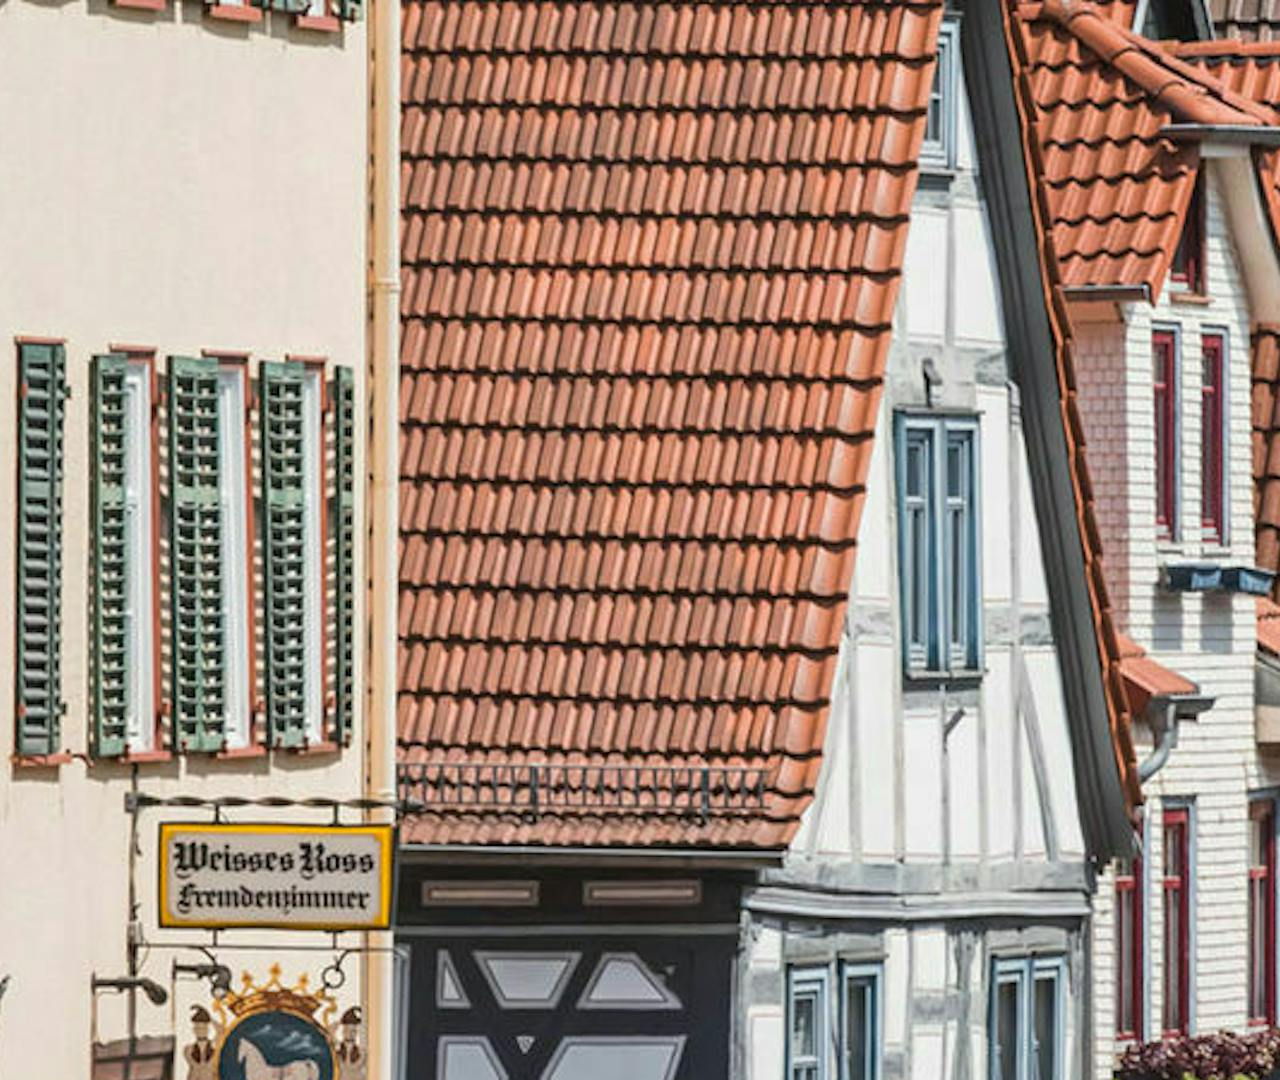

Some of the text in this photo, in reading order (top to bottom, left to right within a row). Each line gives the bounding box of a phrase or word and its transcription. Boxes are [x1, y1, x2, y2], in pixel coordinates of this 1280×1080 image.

[173, 841, 376, 880] Weisses Ross
[176, 883, 370, 916] Fremdenzimmer
